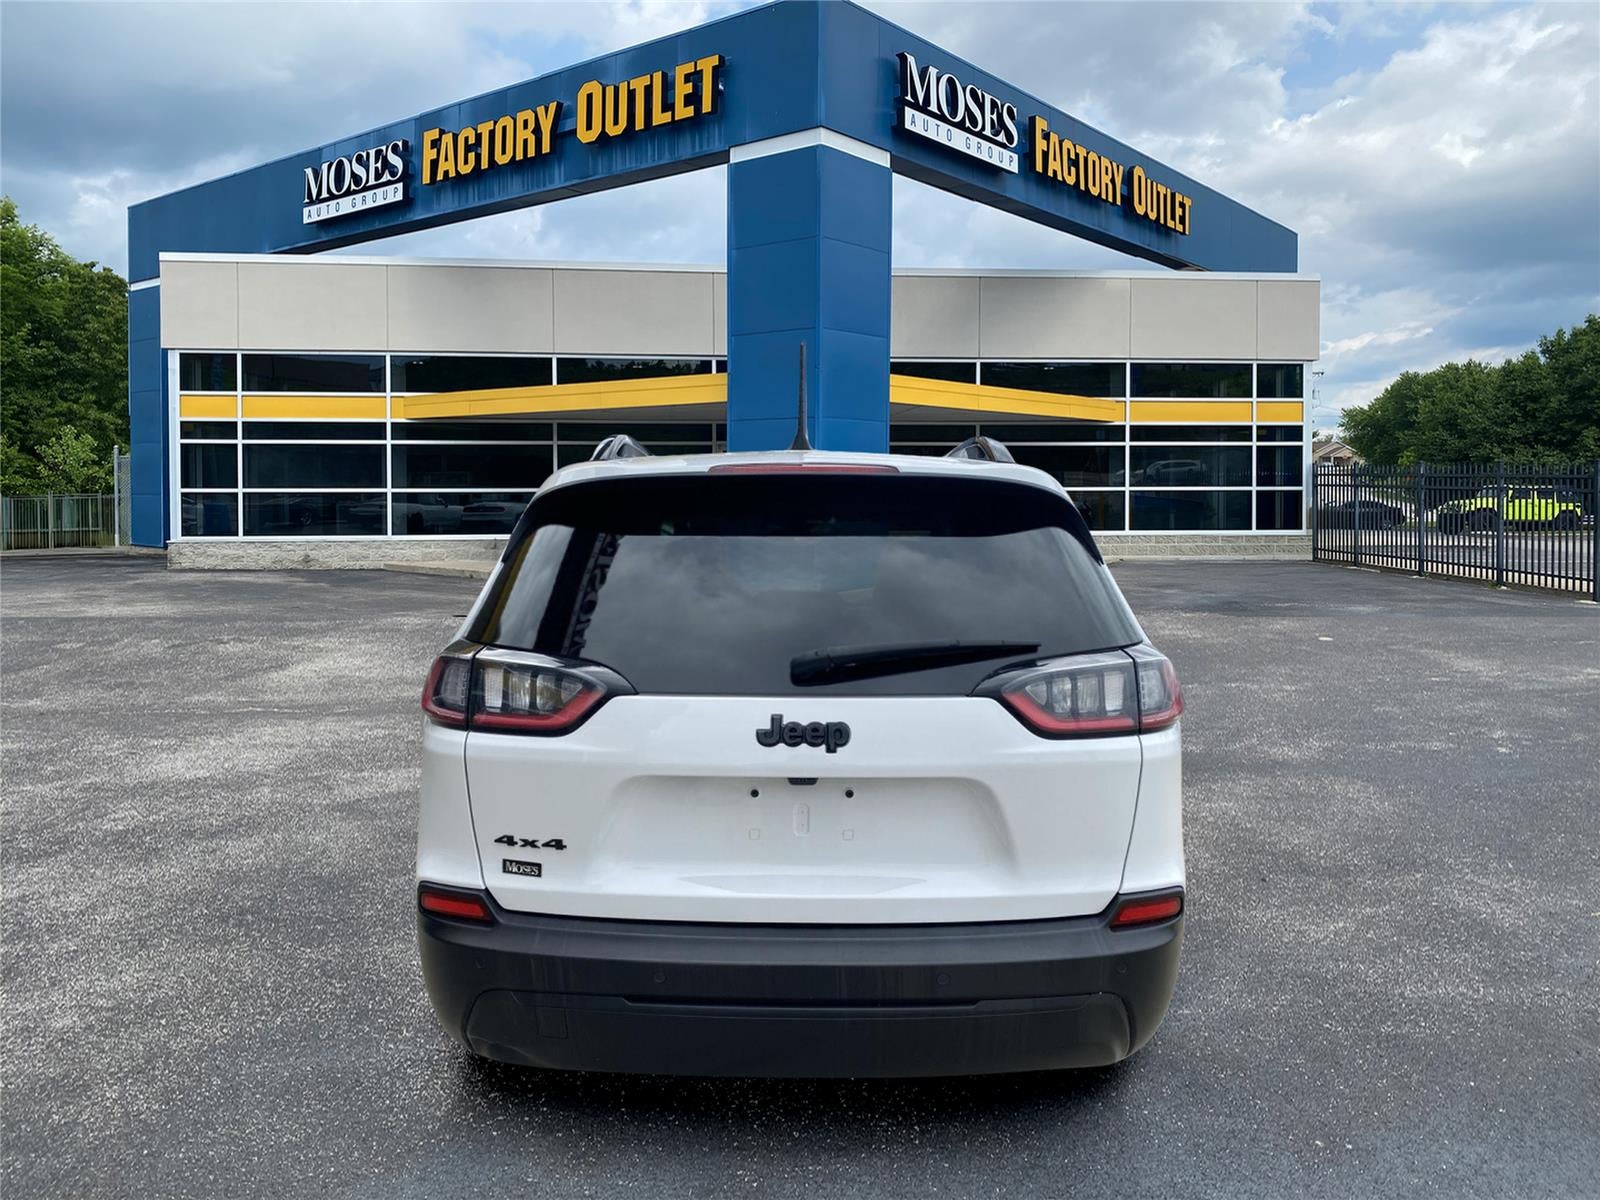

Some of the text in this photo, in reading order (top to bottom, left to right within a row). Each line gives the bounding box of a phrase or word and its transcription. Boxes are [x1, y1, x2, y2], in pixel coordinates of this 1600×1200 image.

[421, 54, 720, 185] FACTORY OUTLET
[904, 52, 1018, 148] MOSES
[910, 113, 1014, 167] AUTO GROUP
[303, 139, 404, 203] MOSES
[1034, 115, 1193, 236] FACTORY OUTLET
[307, 186, 399, 219] AUTO GROUP
[756, 714, 851, 753] Jeep
[494, 834, 567, 850] 4x4
[504, 861, 539, 876] MOSES
